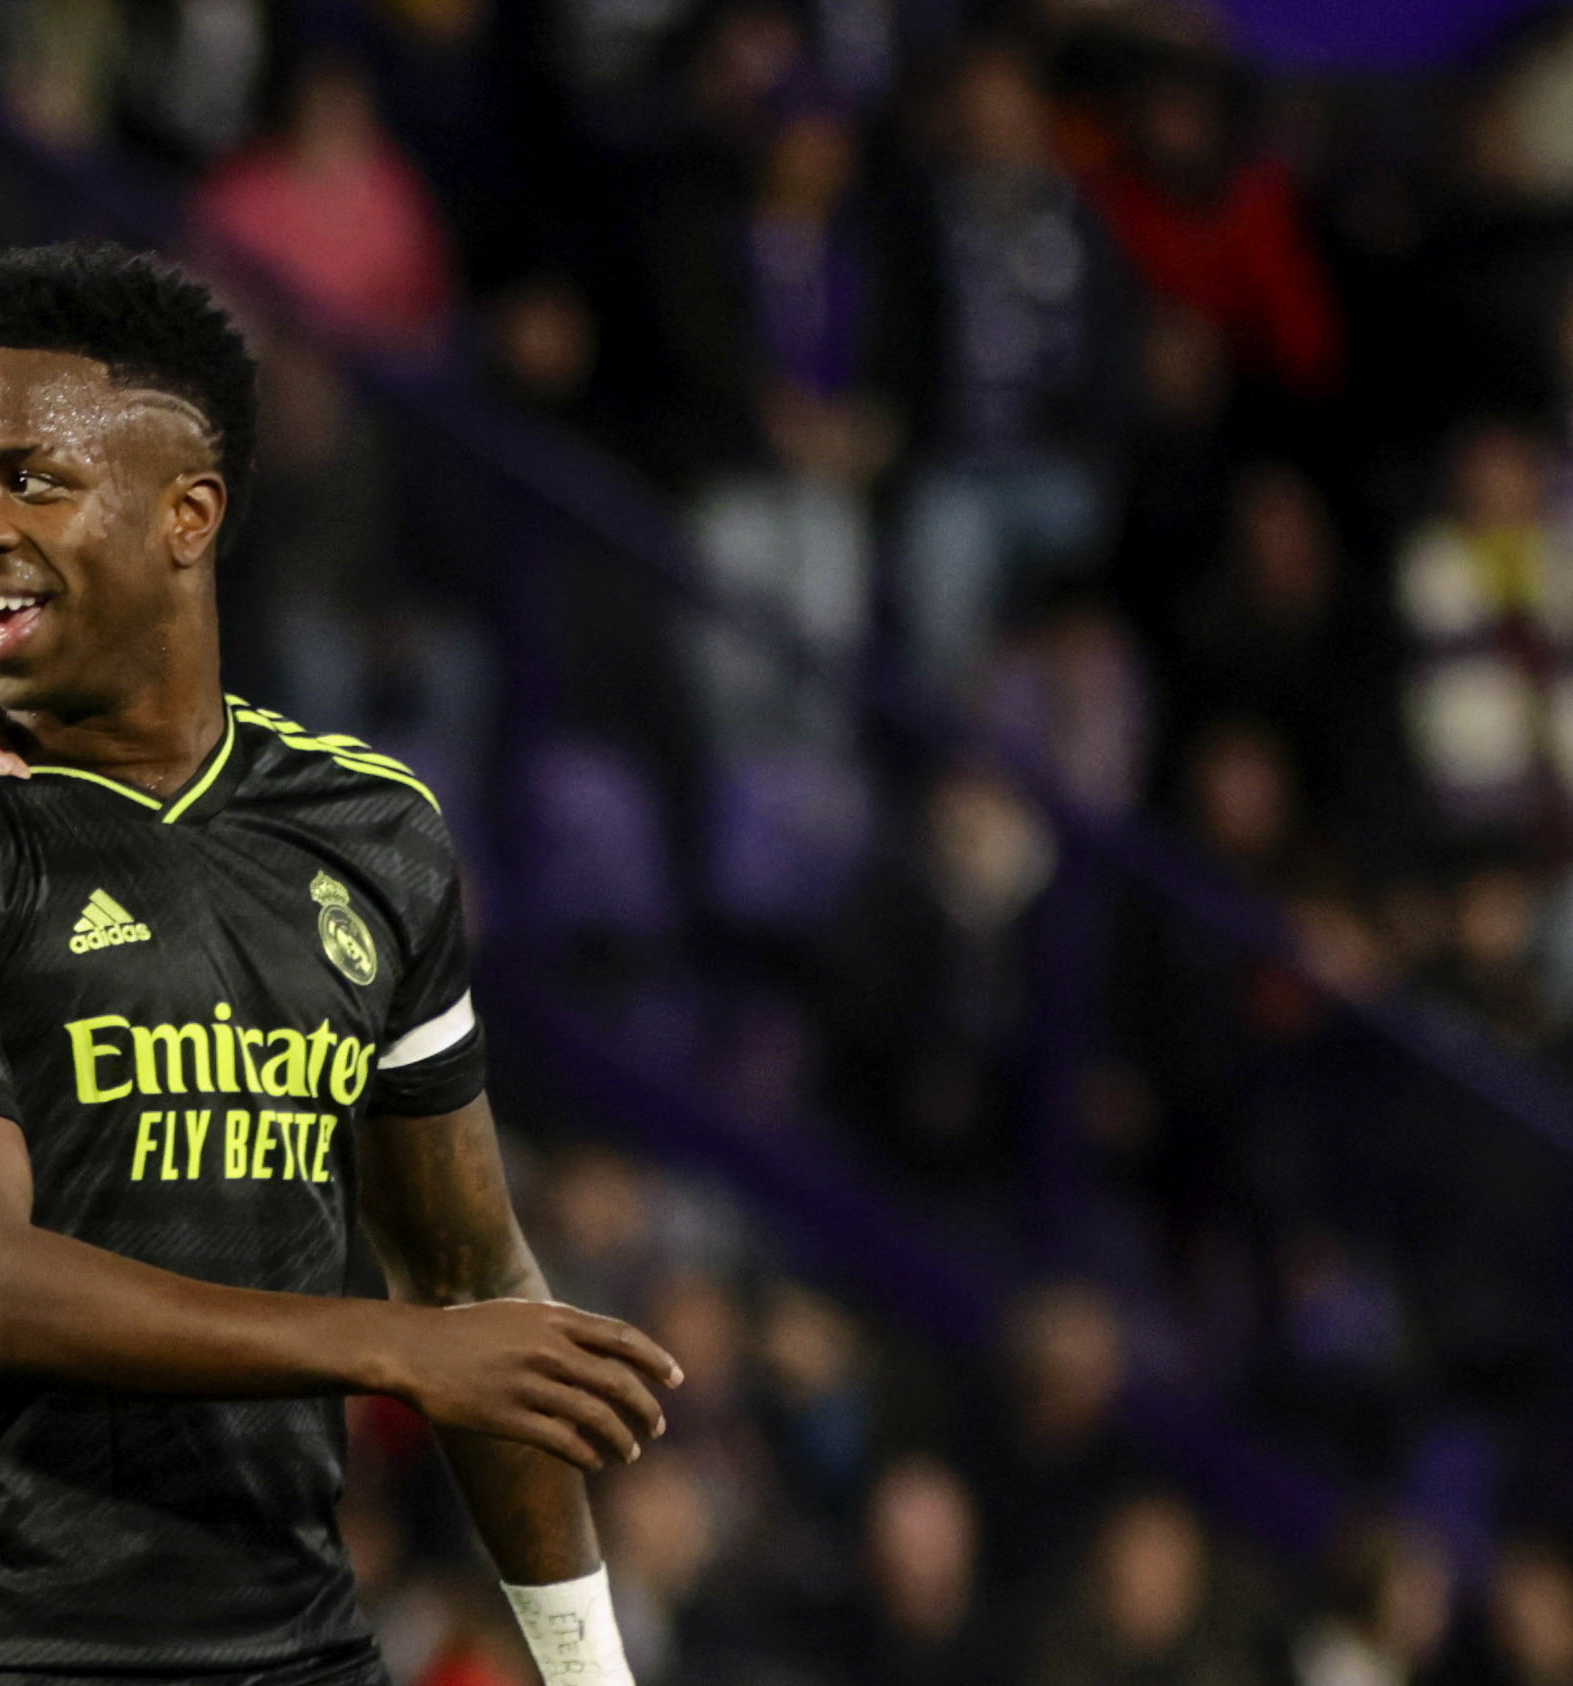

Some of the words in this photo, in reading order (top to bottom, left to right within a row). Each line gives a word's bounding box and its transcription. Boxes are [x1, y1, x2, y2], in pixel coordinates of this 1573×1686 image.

[68, 922, 153, 955] adidas
[130, 1109, 213, 1182] FLY
[223, 1108, 339, 1184] BETTE
